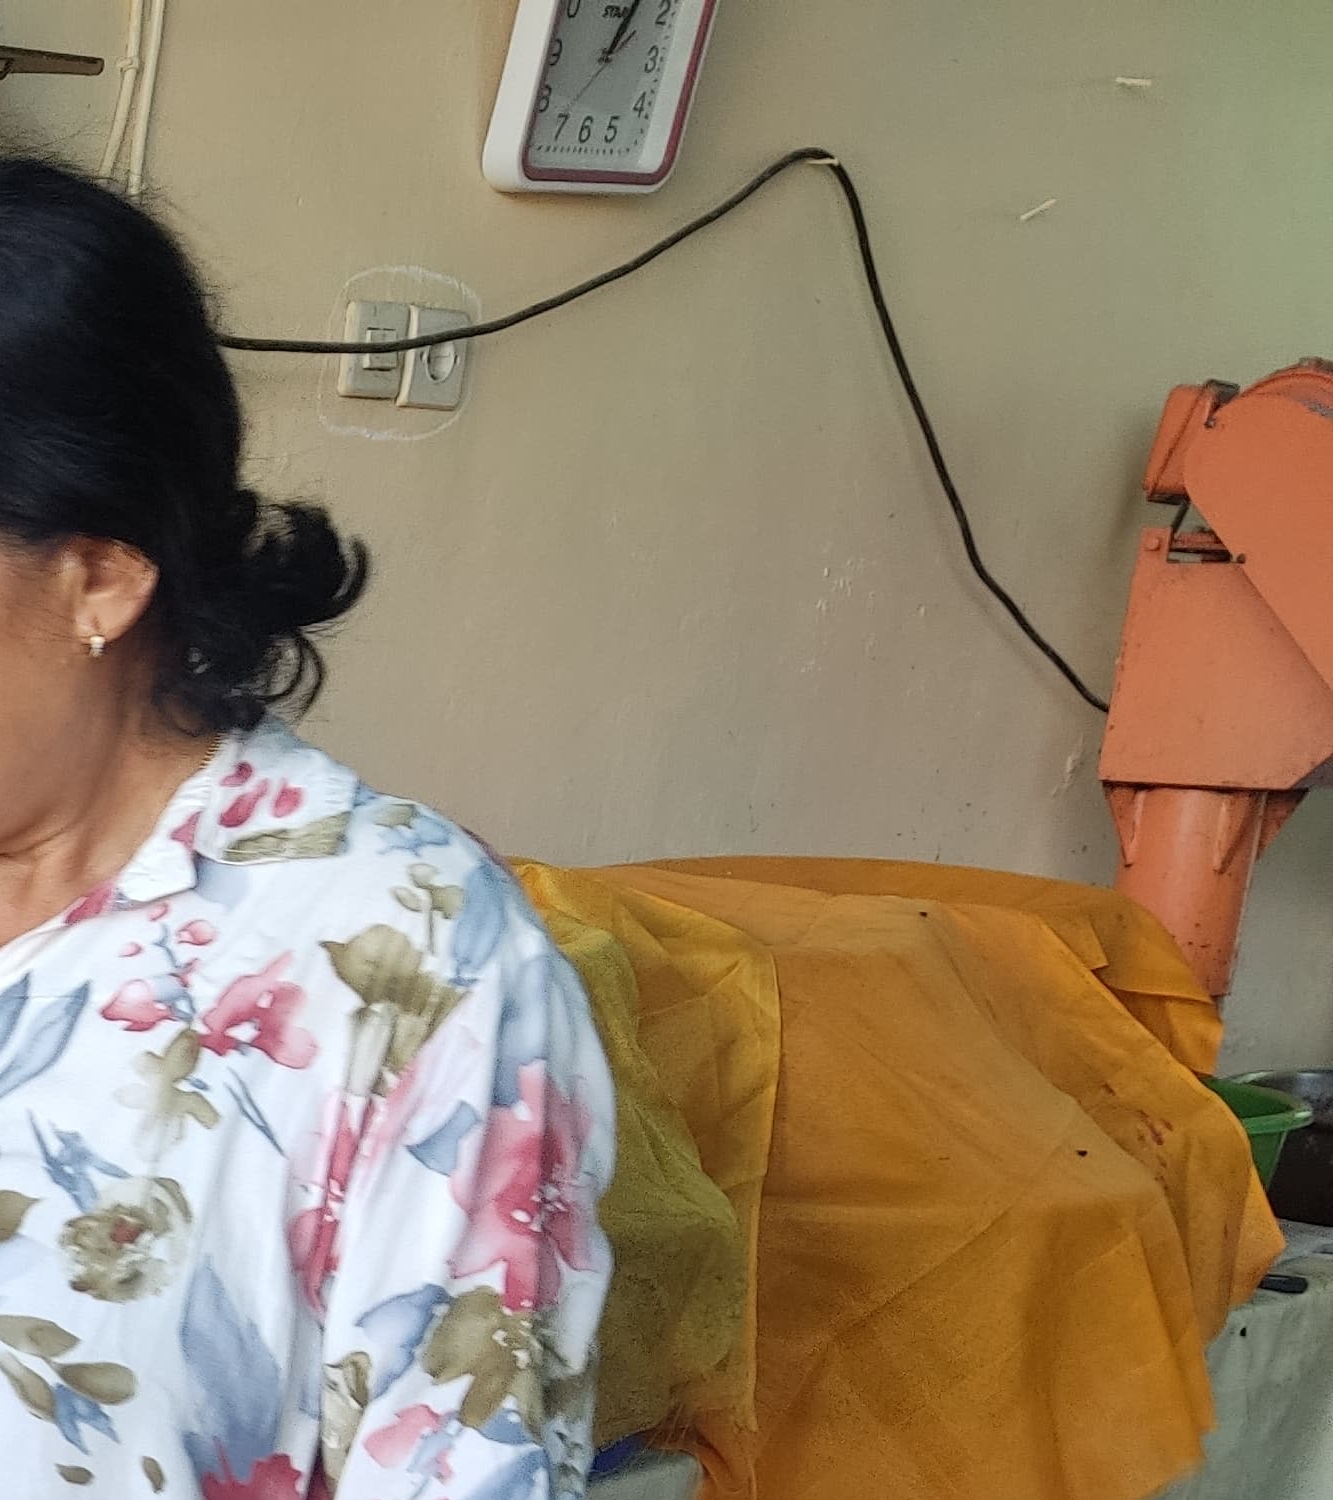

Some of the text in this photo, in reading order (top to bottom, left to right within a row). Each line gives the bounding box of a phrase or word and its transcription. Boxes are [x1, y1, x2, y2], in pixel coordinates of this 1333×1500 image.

[655, 0, 671, 26] 2
[644, 45, 659, 74] 3
[632, 91, 646, 118] 4
[553, 113, 569, 142] 7
[578, 115, 593, 144] 6
[604, 115, 620, 144] 5
